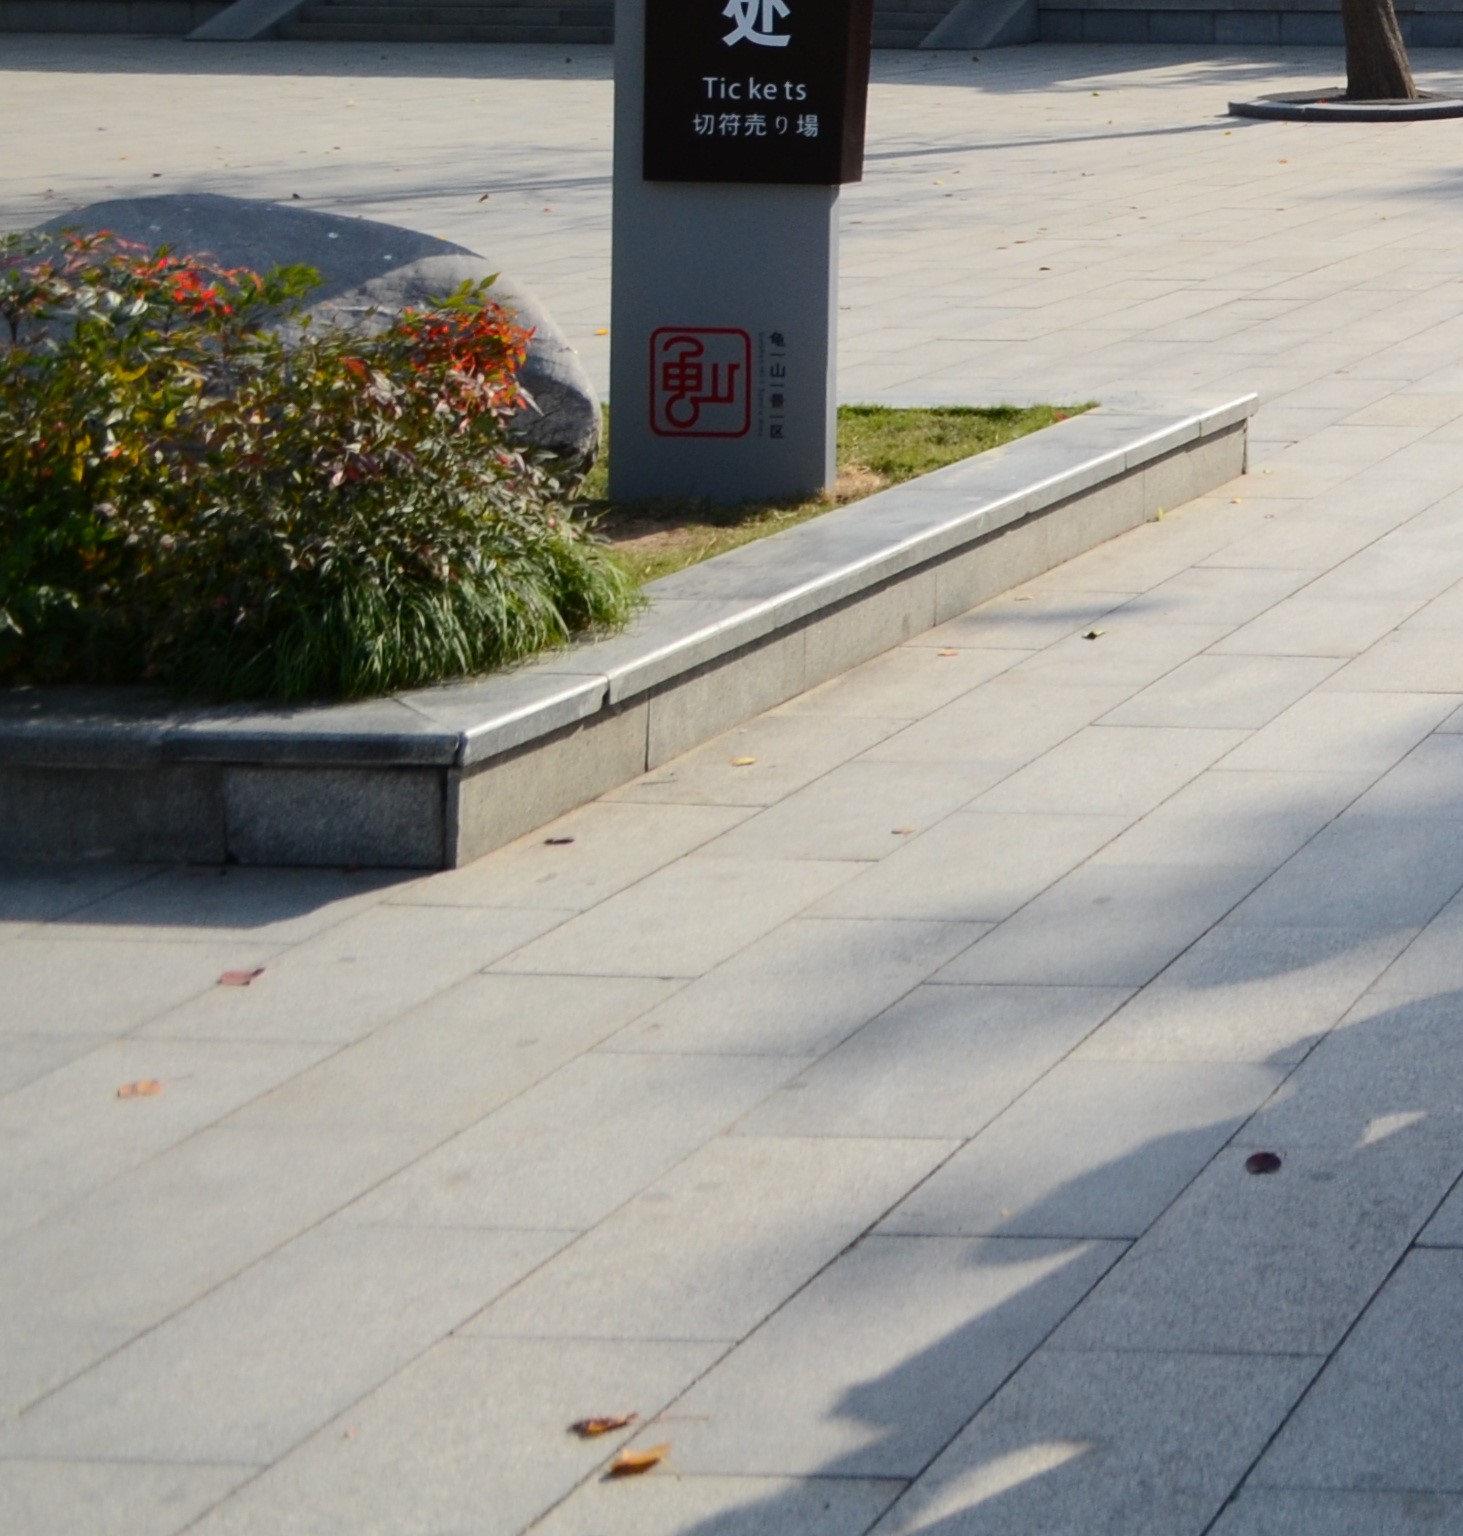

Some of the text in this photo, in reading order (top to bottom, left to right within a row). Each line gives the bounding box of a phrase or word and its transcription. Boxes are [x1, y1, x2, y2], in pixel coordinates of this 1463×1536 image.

[702, 77, 806, 101] Tickets
[693, 113, 819, 137] 切符売り場
